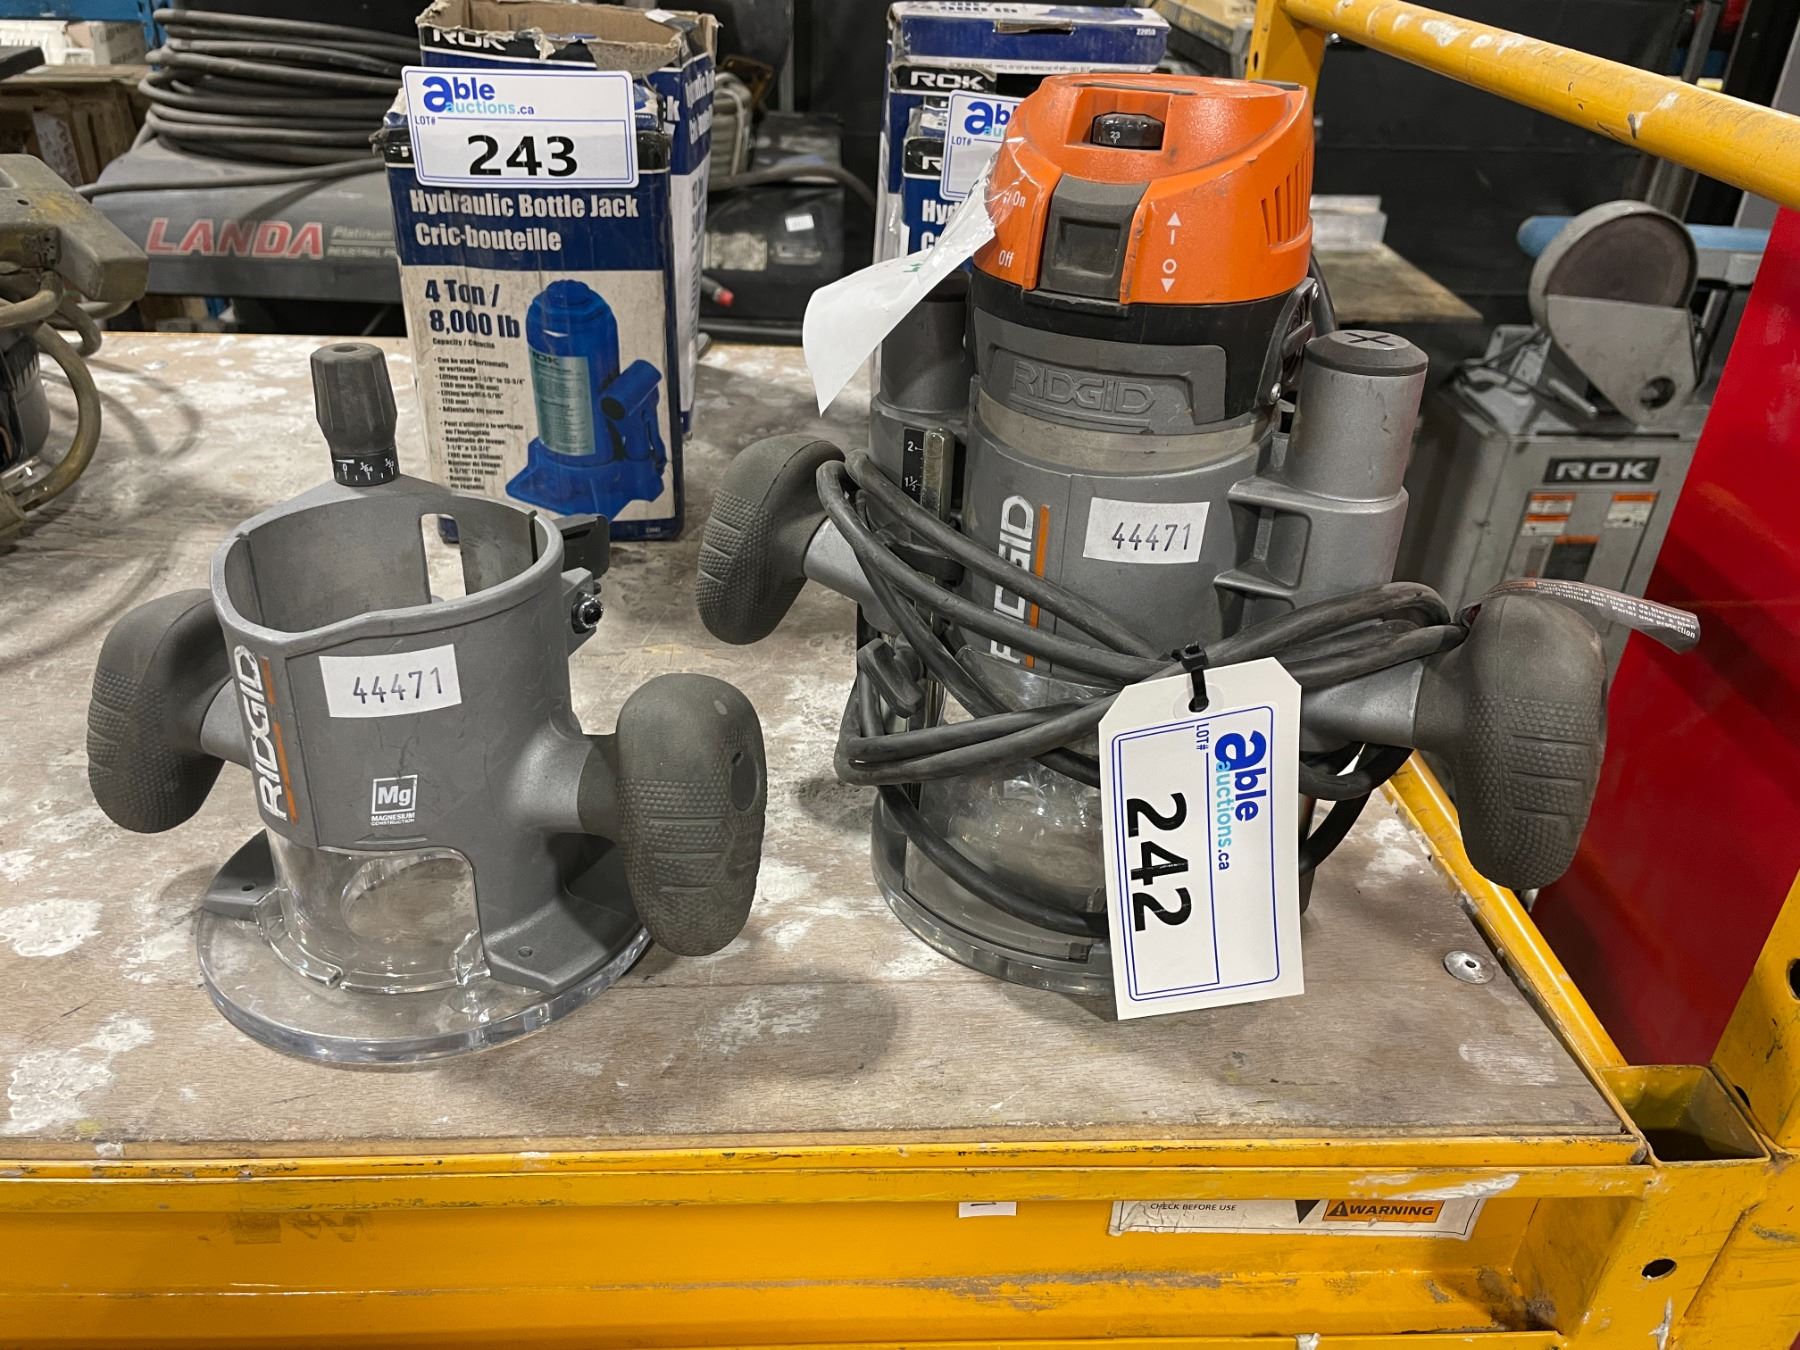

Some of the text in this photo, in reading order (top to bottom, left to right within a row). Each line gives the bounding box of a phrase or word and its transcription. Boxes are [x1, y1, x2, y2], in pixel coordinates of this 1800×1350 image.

[423, 76, 496, 113] able
[910, 71, 984, 90] ROK
[415, 115, 436, 126] LOT#
[445, 100, 535, 116] auctions.ca
[467, 134, 578, 178] 243
[951, 136, 972, 146] LOT#
[409, 189, 640, 219] Hydraulic Bottle Jack
[146, 217, 325, 260] LANDA
[414, 222, 562, 252] Cric-bouteille
[998, 249, 1015, 268] Off
[425, 279, 441, 304] 4
[443, 279, 486, 306] Ton
[429, 309, 521, 339] 8,000 lb
[1010, 360, 1156, 415] RIDGID
[1556, 461, 1650, 480] ROK
[1111, 521, 1192, 552] 44471
[353, 666, 443, 705] 44471
[233, 645, 288, 822] RIDGID
[1196, 722, 1210, 752] LOT#
[1214, 730, 1267, 823] able
[377, 785, 412, 807] Mg
[370, 811, 416, 822] MAGNESIUM
[1215, 760, 1232, 871] auctions.ca
[1126, 791, 1193, 933] 242
[1150, 1203, 1238, 1212] CHECK BEFORE USE
[1349, 1203, 1435, 1217] WARNING
